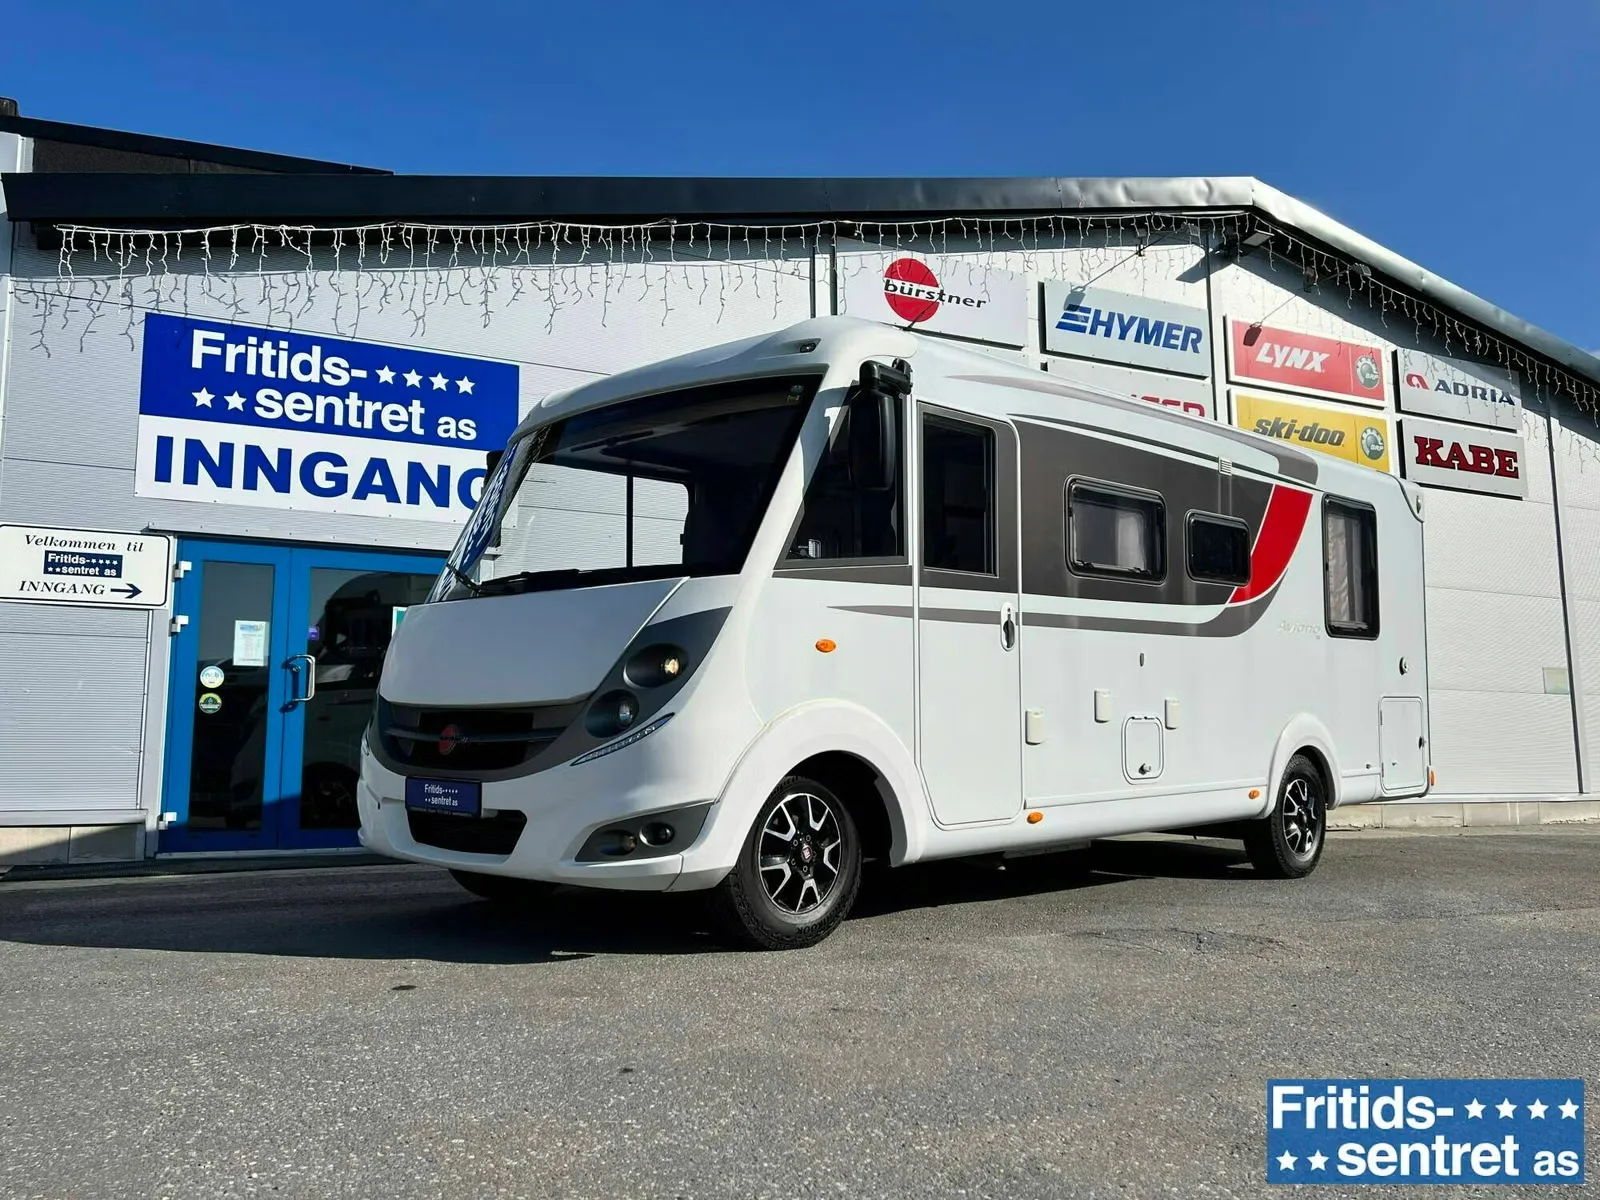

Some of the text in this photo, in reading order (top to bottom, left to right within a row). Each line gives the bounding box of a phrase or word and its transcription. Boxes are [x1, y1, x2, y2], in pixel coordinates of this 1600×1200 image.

[883, 279, 987, 309] bürstner
[1088, 308, 1204, 354] HYMER
[191, 329, 368, 387] Fritids-
[1256, 342, 1331, 373] LYNX
[1434, 379, 1516, 406] ADRIA
[254, 387, 477, 441] sentret as
[1252, 417, 1345, 447] ski-doo
[1414, 436, 1519, 479] KABE
[25, 534, 144, 553] Velkommen til
[47, 553, 91, 565] Fritids-
[61, 565, 117, 577] sentret as
[19, 580, 106, 596] INNGANG
[431, 795, 459, 807] sentret as
